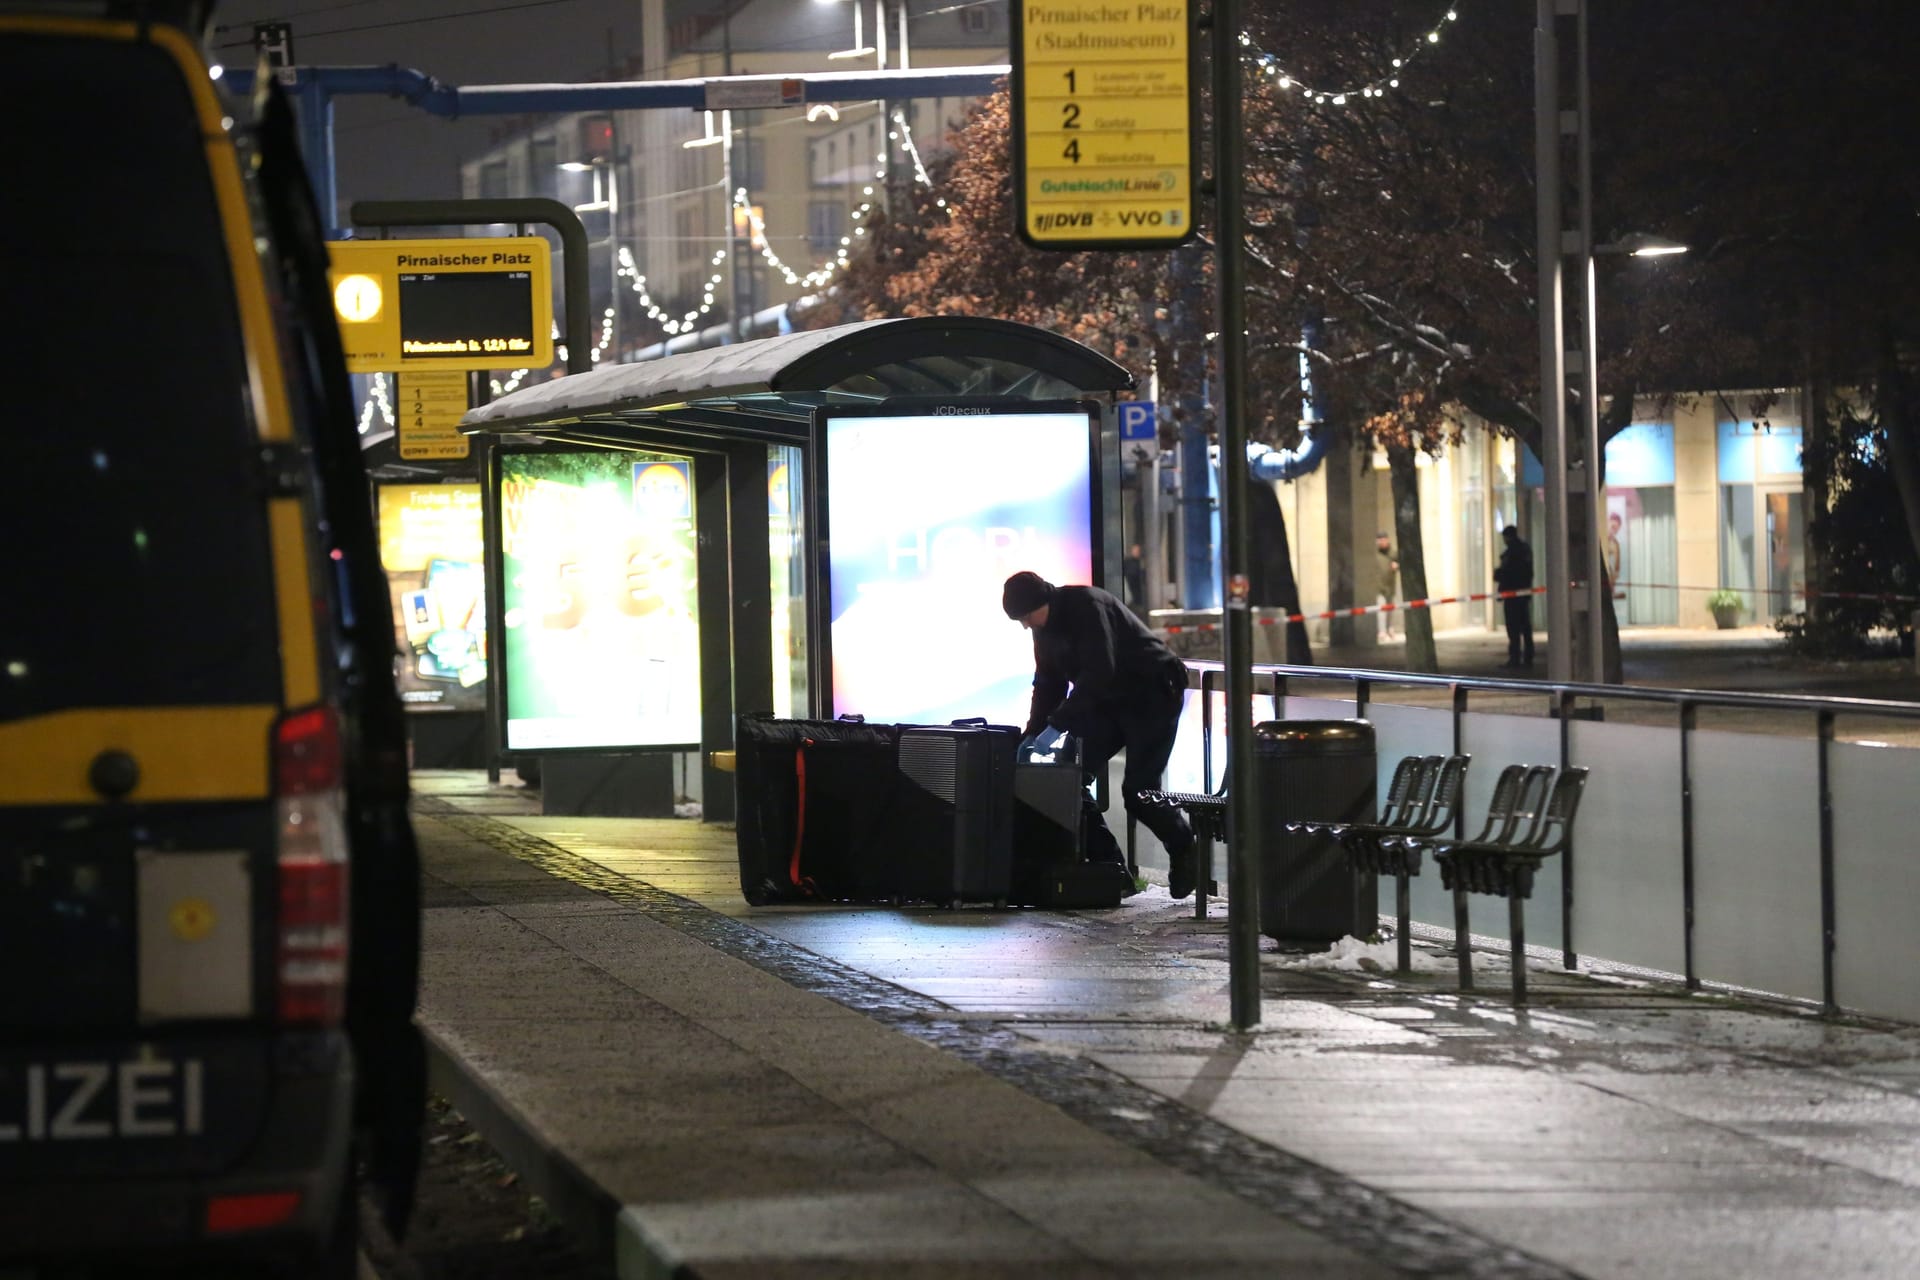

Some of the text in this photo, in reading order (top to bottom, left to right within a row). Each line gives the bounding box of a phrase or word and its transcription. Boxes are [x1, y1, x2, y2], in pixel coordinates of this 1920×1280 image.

[1028, 4, 1182, 24] Pirnaischer Platz
[1035, 32, 1176, 51] (Stadtmuseum)
[1063, 68, 1076, 94] 1
[1062, 104, 1081, 129] 2
[1062, 139, 1081, 163] 4
[1118, 210, 1162, 227] VVO
[397, 252, 531, 267] Pirnaischer Platz
[415, 387, 421, 399] 1
[414, 402, 423, 414] 2
[932, 406, 991, 417] JCDecaux
[415, 416, 423, 428] 4
[1125, 406, 1147, 437] P
